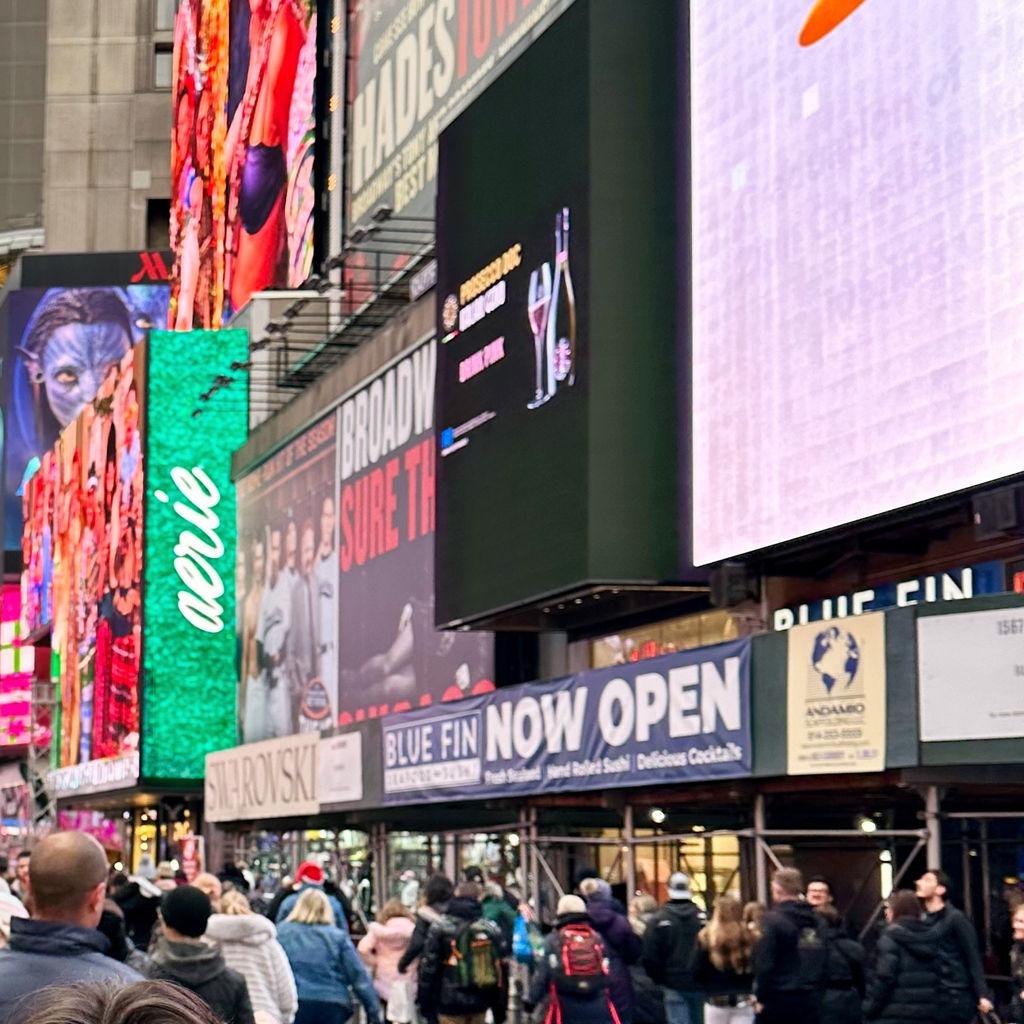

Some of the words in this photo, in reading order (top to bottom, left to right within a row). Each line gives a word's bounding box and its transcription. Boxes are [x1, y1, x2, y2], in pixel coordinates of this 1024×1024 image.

[153, 465, 225, 634] aerie
[341, 458, 400, 572] SURE
[385, 725, 433, 768] BLUE
[440, 716, 476, 760] FIN
[486, 687, 588, 762] NOW
[598, 656, 741, 747] OPEN
[208, 744, 318, 812] SWAROVSKI
[637, 749, 688, 770] Delicious
[687, 742, 743, 765] Cocktails
